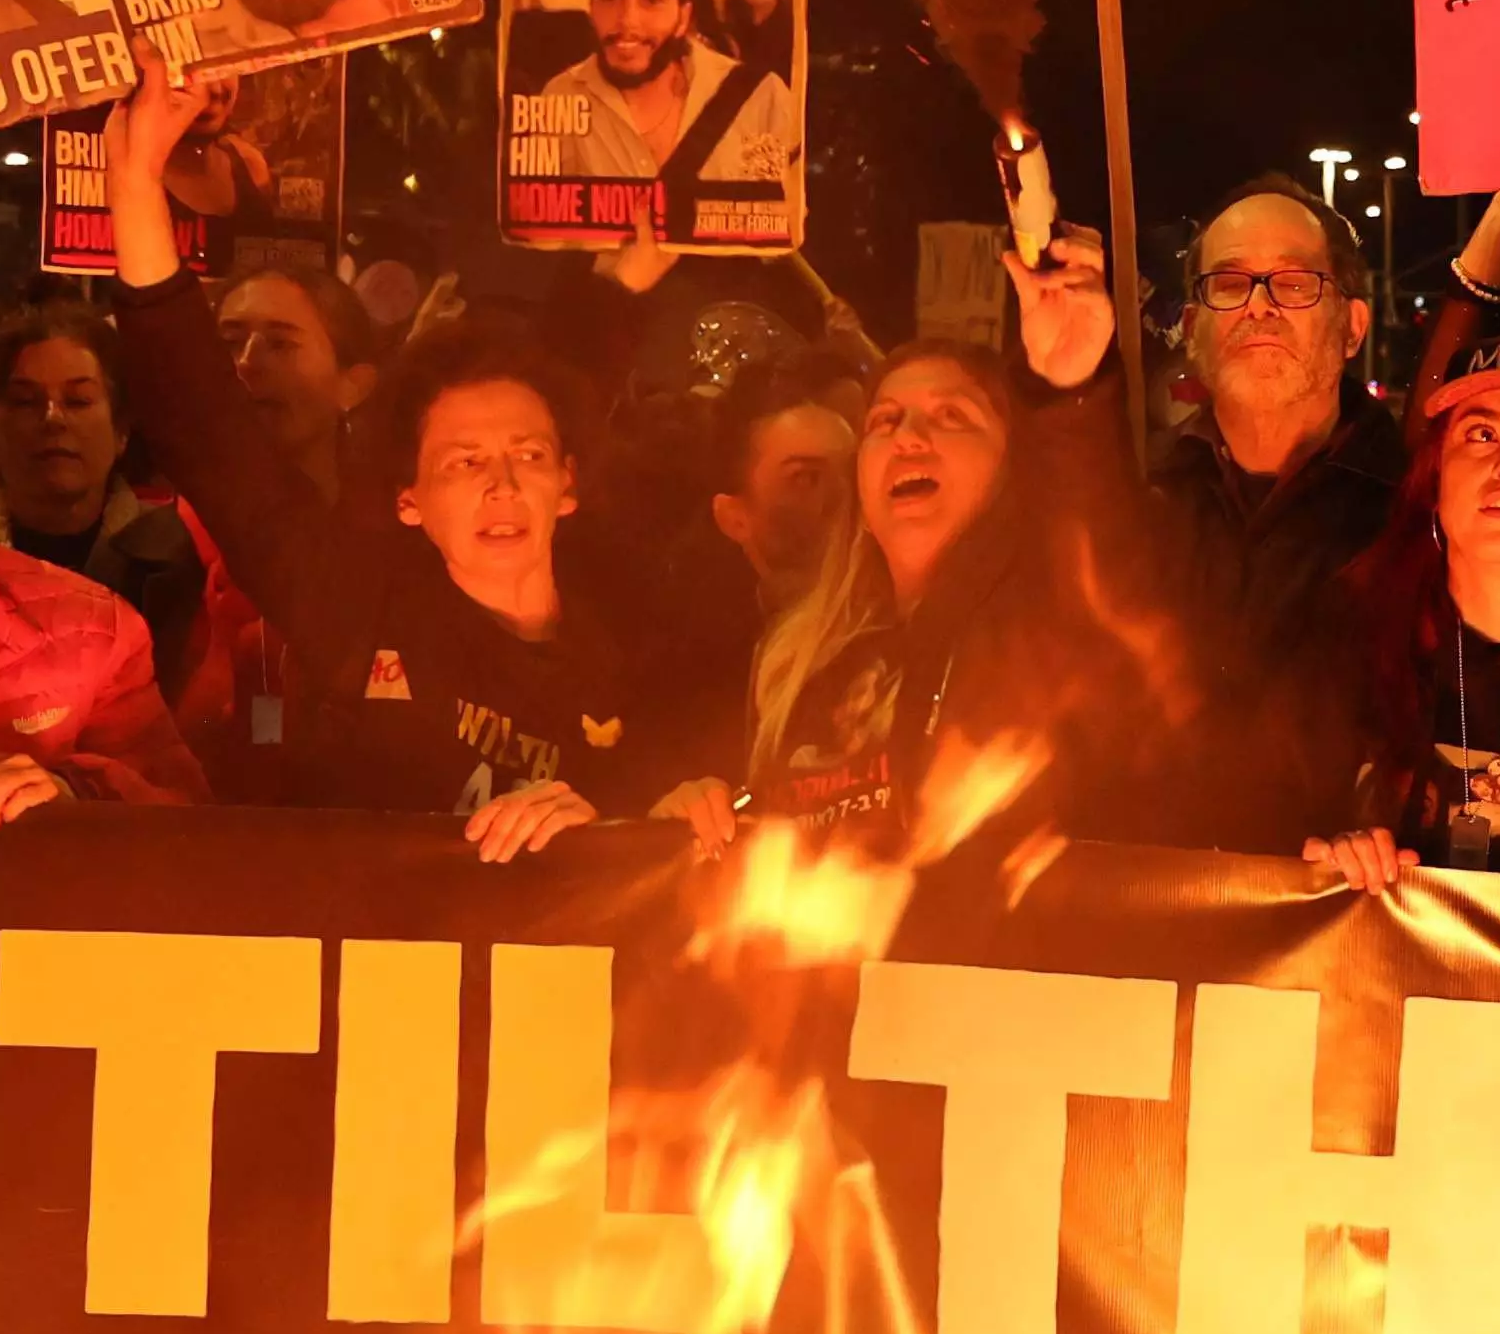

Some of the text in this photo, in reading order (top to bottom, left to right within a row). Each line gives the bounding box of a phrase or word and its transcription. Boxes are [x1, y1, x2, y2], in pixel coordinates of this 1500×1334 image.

[13, 30, 137, 105] OFER
[511, 94, 591, 136] BRING
[509, 136, 561, 177] HIM
[509, 182, 584, 223] HOME
[54, 212, 113, 250] HOM
